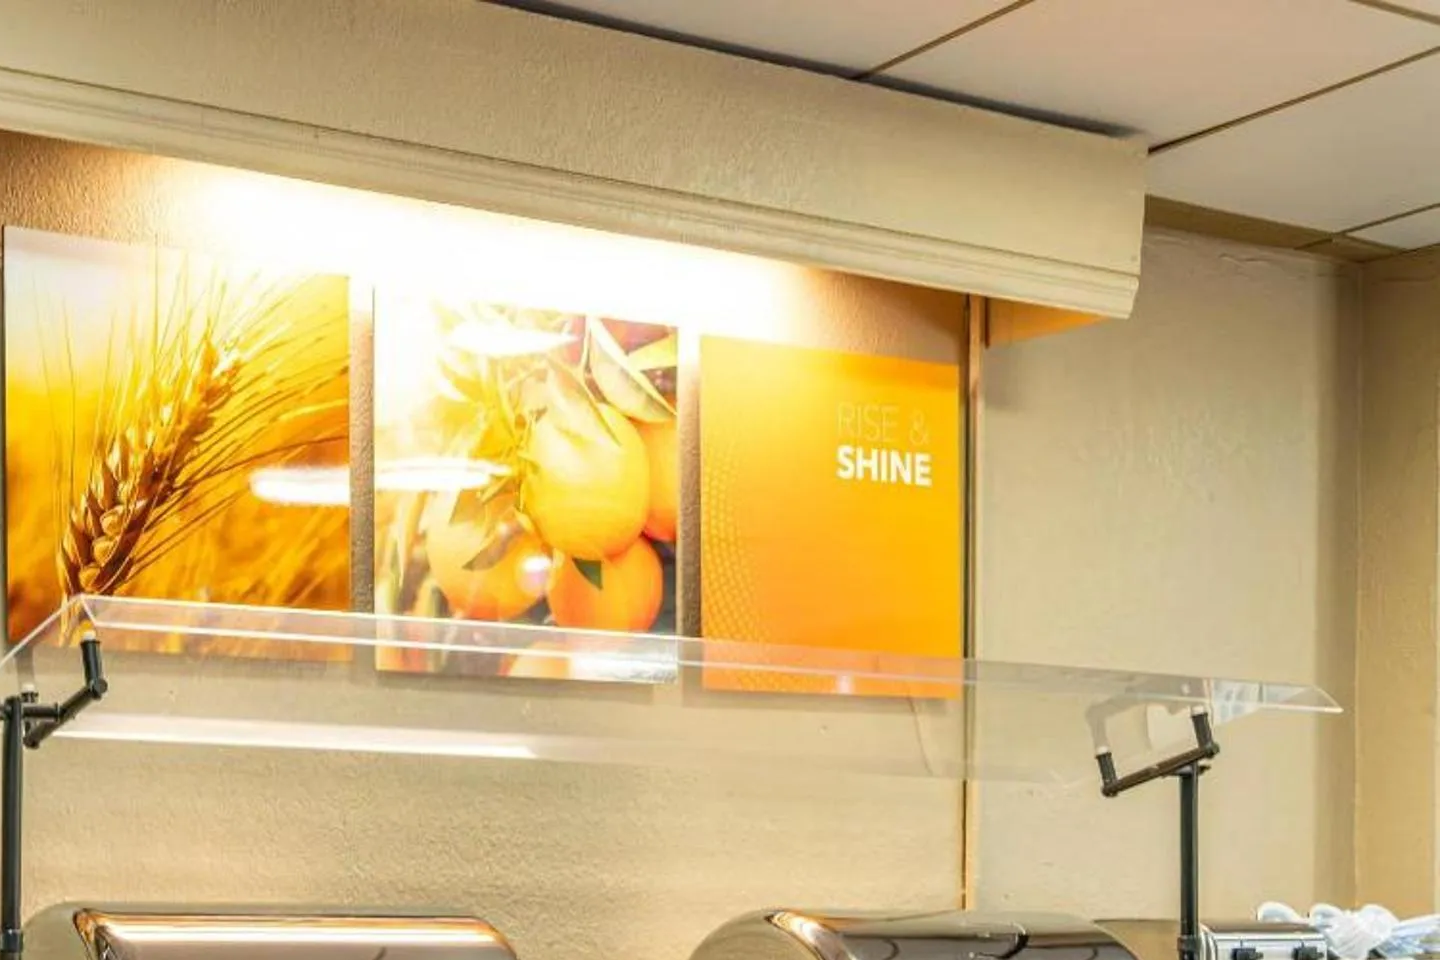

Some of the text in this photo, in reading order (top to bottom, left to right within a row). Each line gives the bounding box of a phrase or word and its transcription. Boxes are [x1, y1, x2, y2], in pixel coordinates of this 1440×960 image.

[837, 402, 929, 446] RISE &
[836, 444, 933, 488] SHINE
